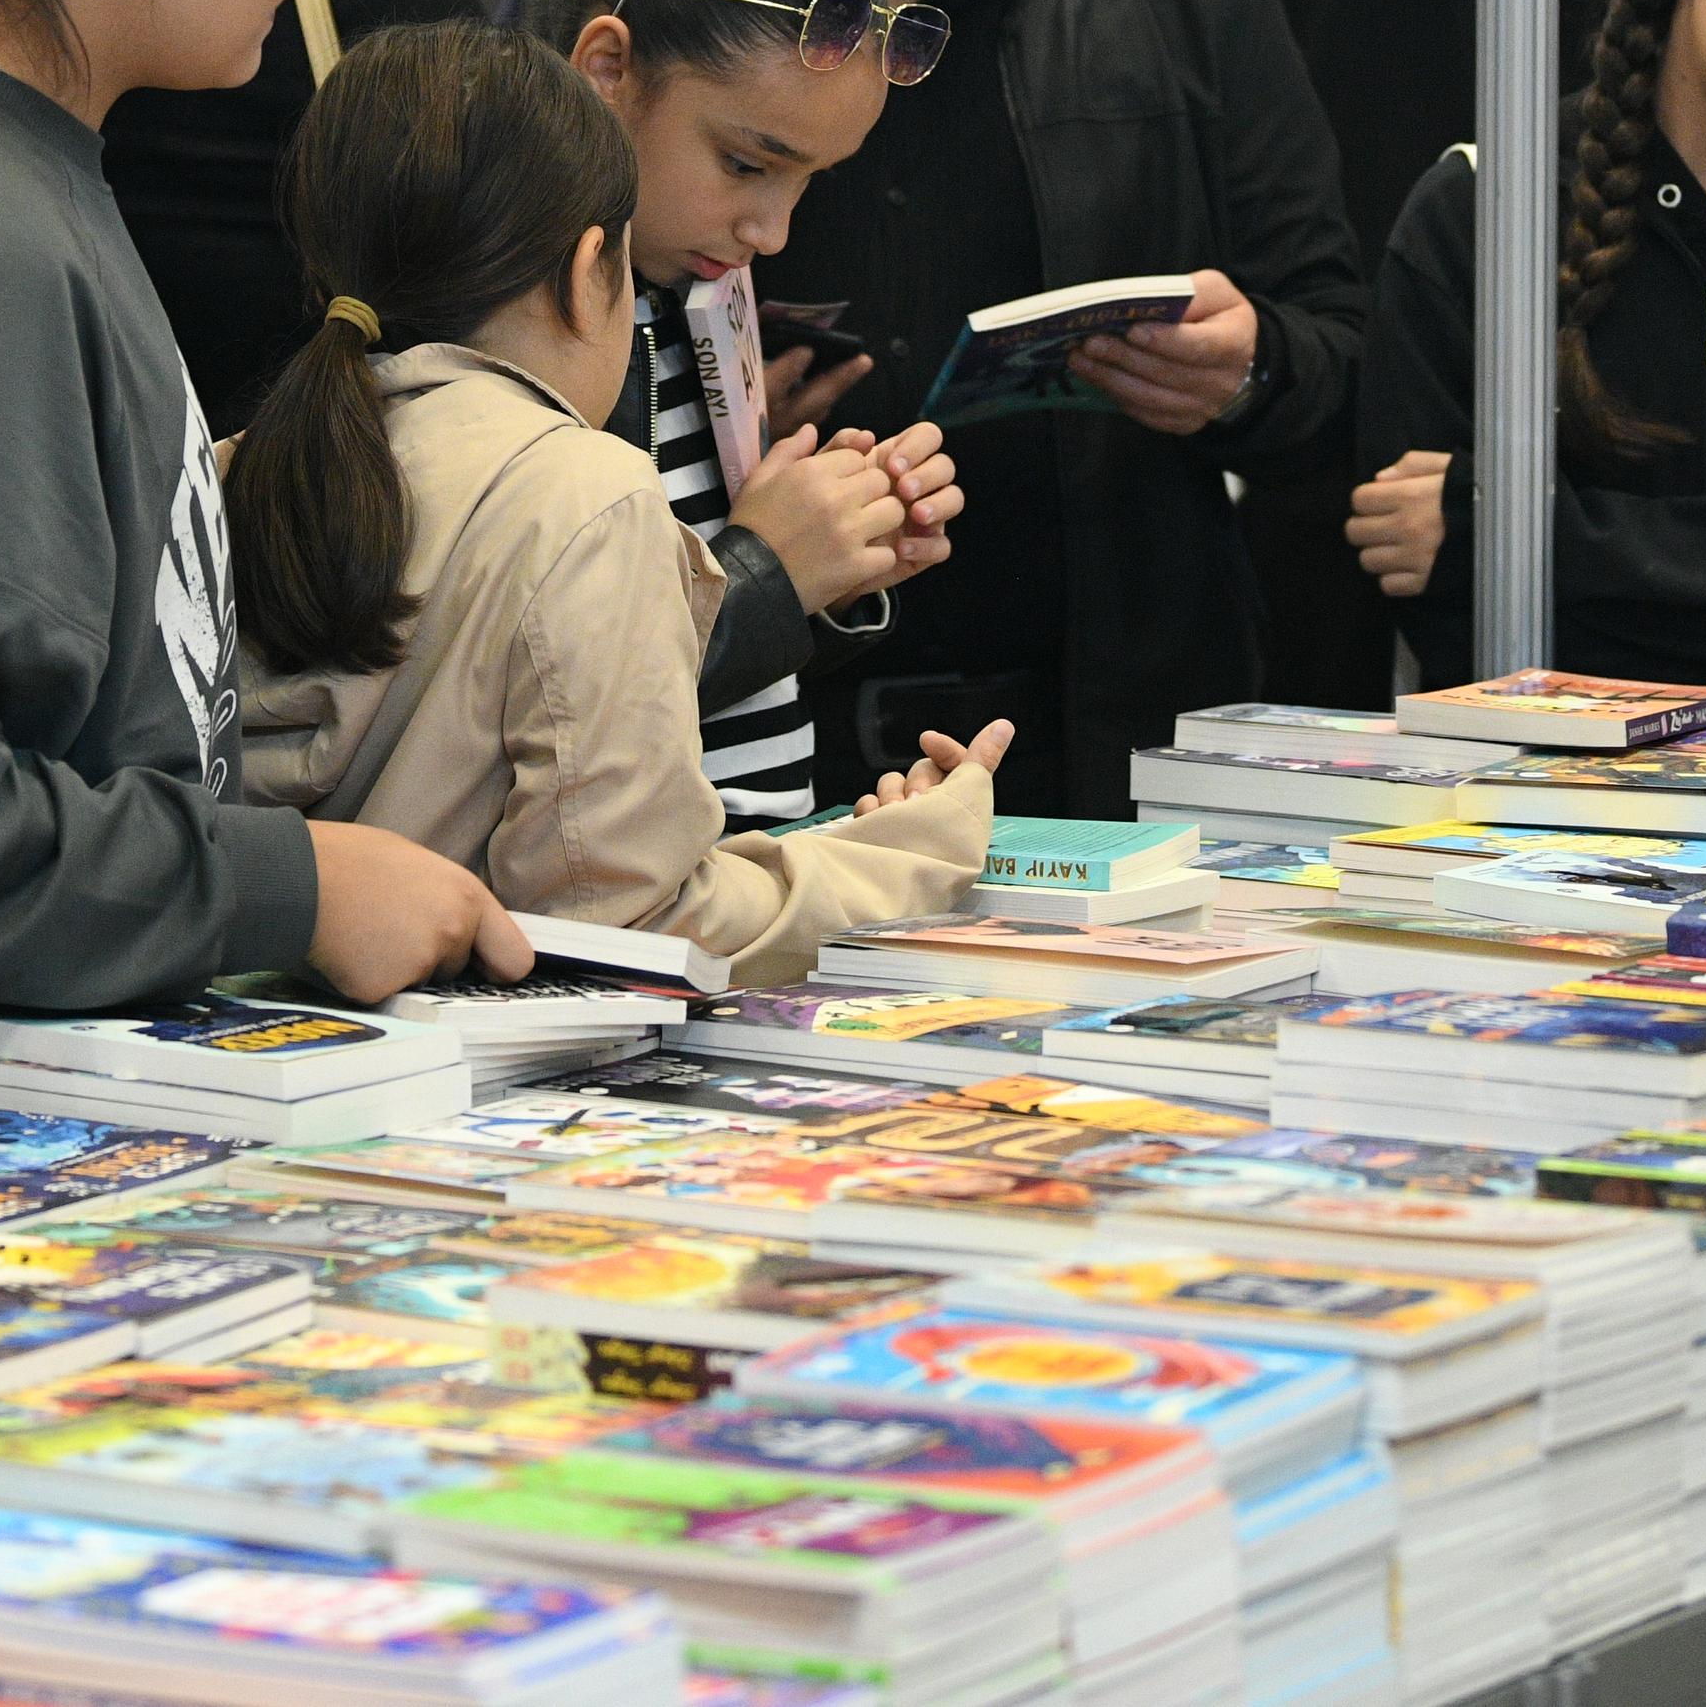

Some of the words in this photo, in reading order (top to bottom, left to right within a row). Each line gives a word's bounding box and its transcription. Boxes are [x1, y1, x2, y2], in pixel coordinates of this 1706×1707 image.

[693, 337, 722, 382] SON
[703, 387, 730, 419] AYI
[1024, 860, 1088, 882] KAYIP
